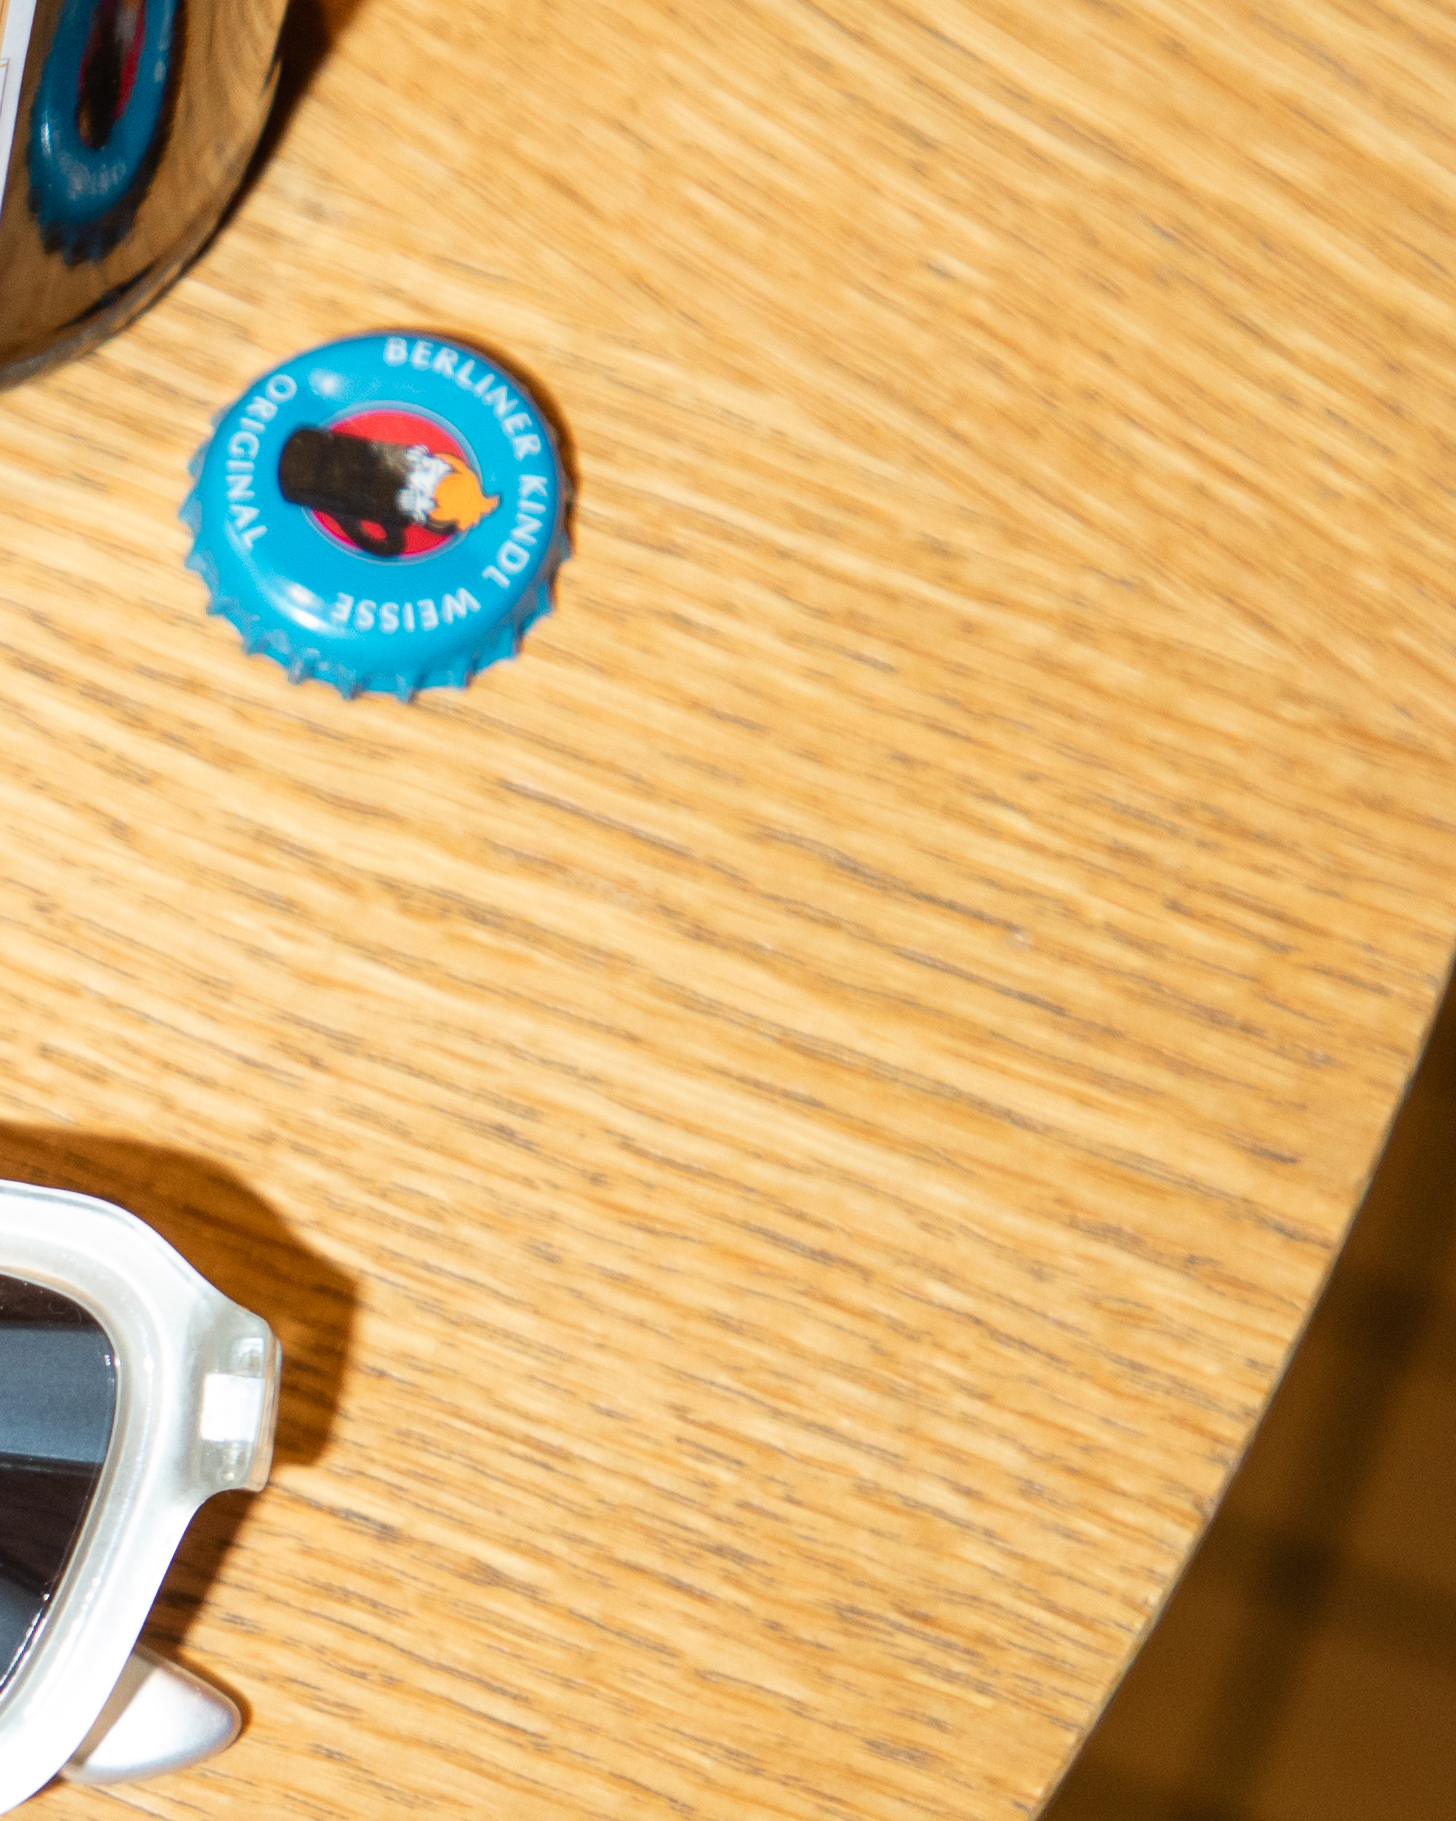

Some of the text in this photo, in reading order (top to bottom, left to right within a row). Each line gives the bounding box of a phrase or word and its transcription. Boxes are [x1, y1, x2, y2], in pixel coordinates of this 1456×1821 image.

[225, 336, 549, 634] BERLINER KINDL WEISSE ORIGINAL
